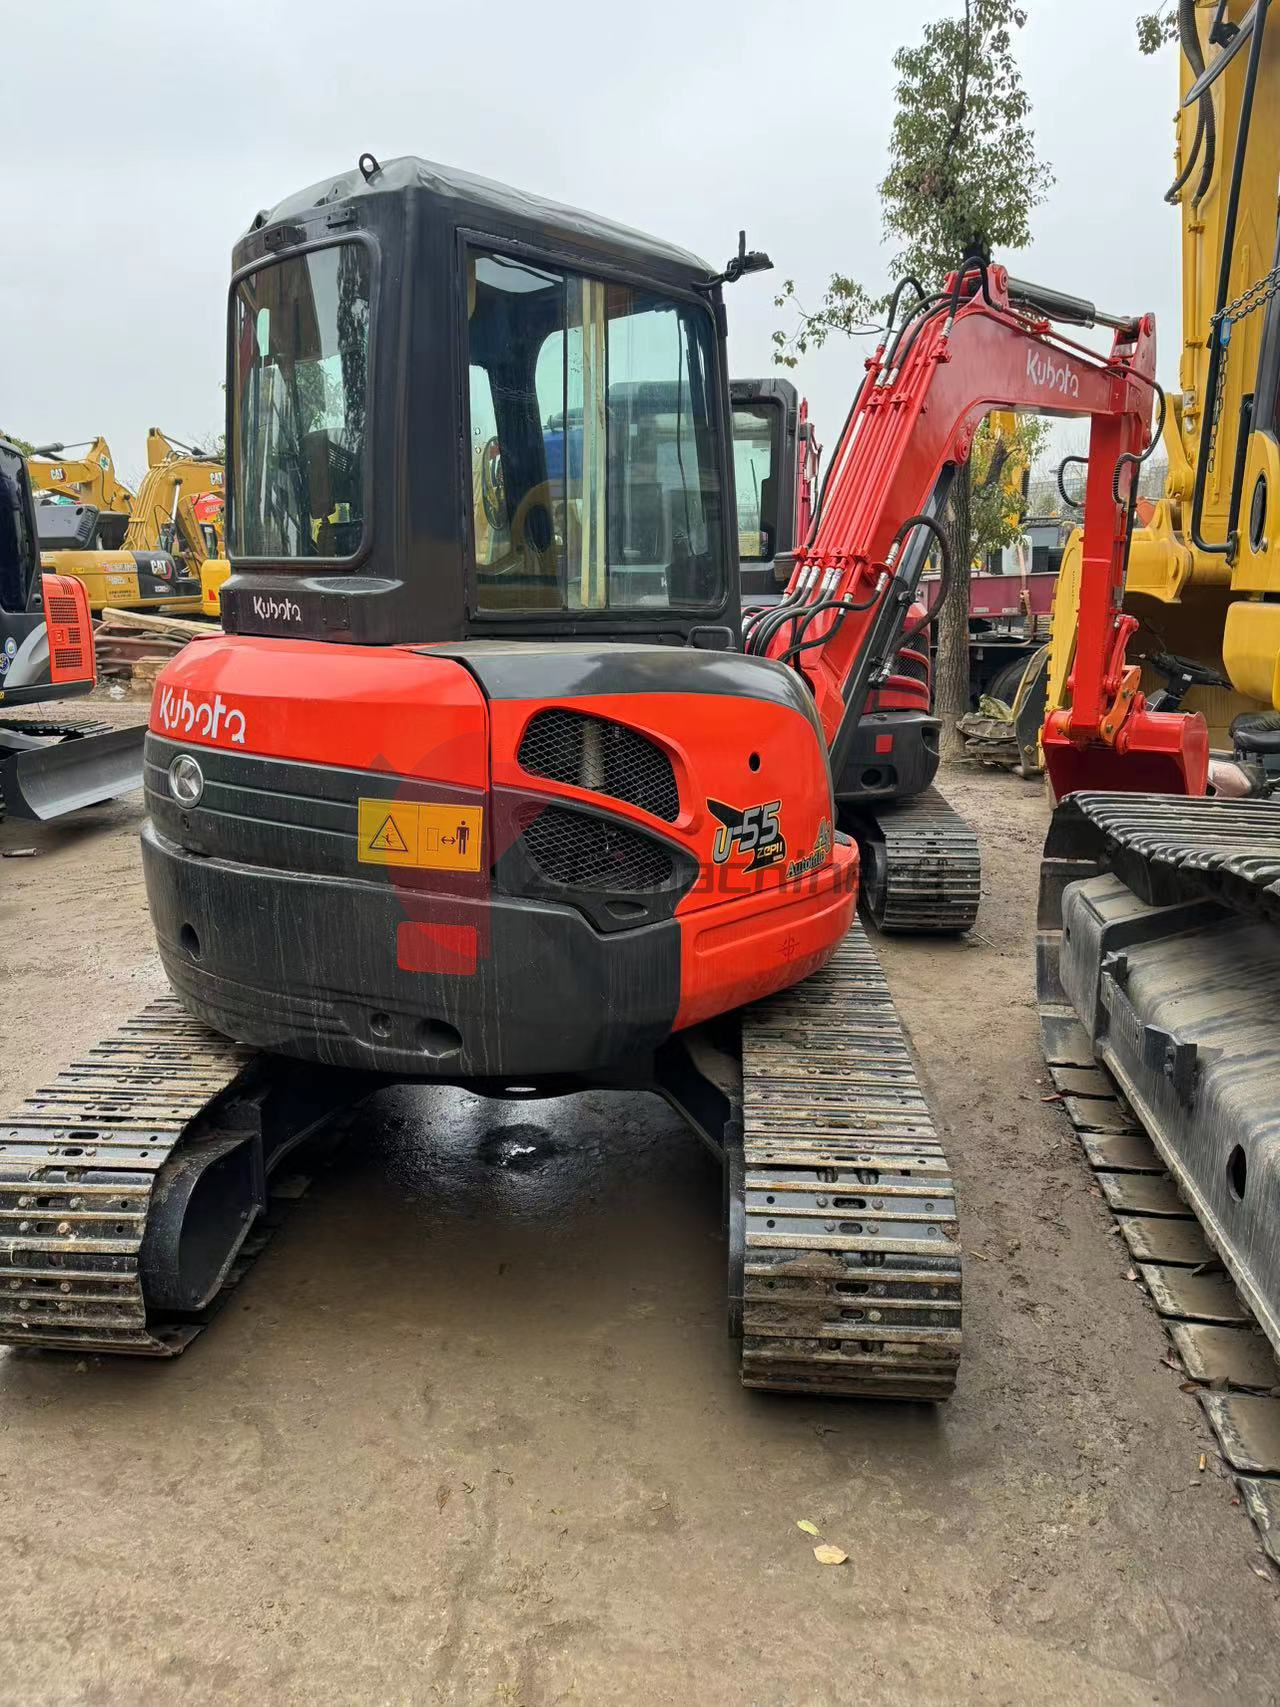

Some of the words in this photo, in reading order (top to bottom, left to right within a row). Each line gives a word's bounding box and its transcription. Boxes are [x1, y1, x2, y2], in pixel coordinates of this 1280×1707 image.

[1026, 348, 1079, 398] Kubota
[50, 468, 64, 481] CAT
[209, 472, 223, 486] CAT
[150, 559, 168, 576] CAT
[253, 596, 302, 622] Kubota
[159, 685, 246, 744] Kubota
[712, 800, 782, 864] U-55
